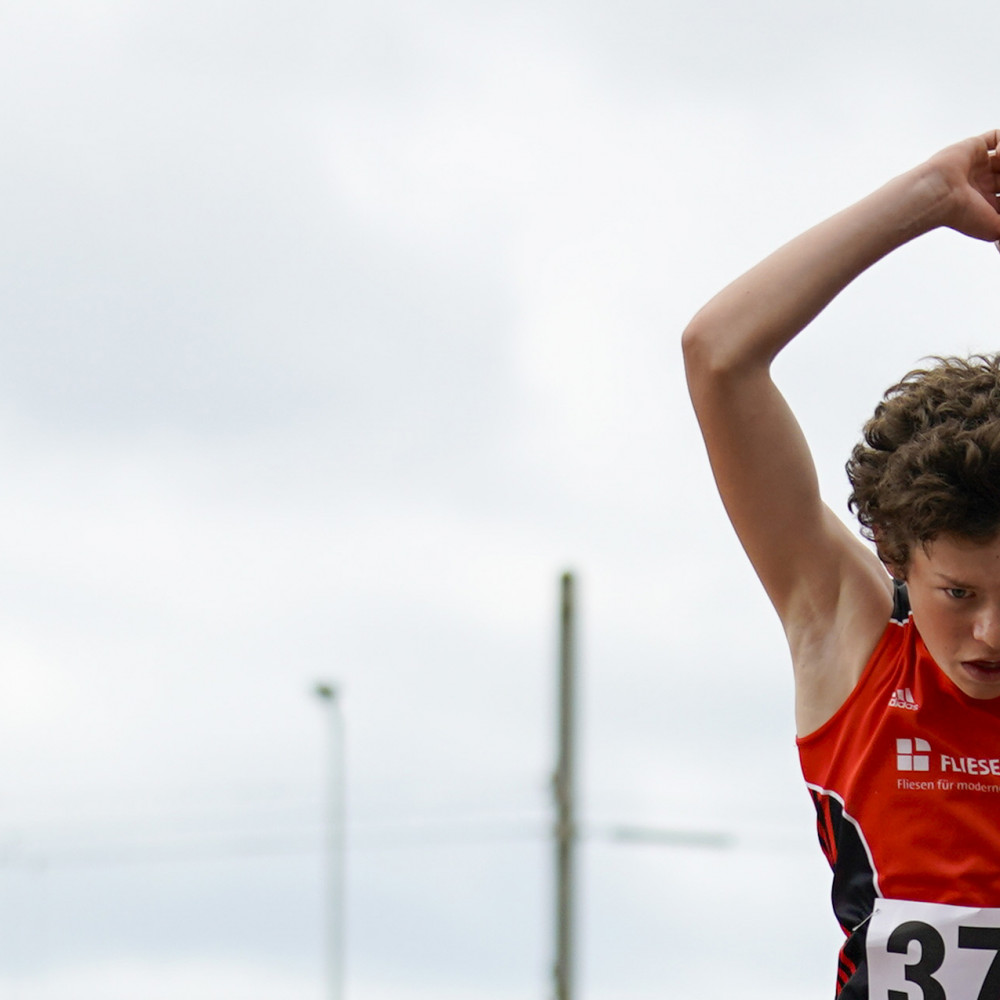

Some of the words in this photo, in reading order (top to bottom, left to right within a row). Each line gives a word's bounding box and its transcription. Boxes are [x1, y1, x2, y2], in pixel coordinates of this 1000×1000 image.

[888, 697, 919, 711] adidas
[897, 778, 934, 790] Fliesen
[937, 778, 954, 791] für
